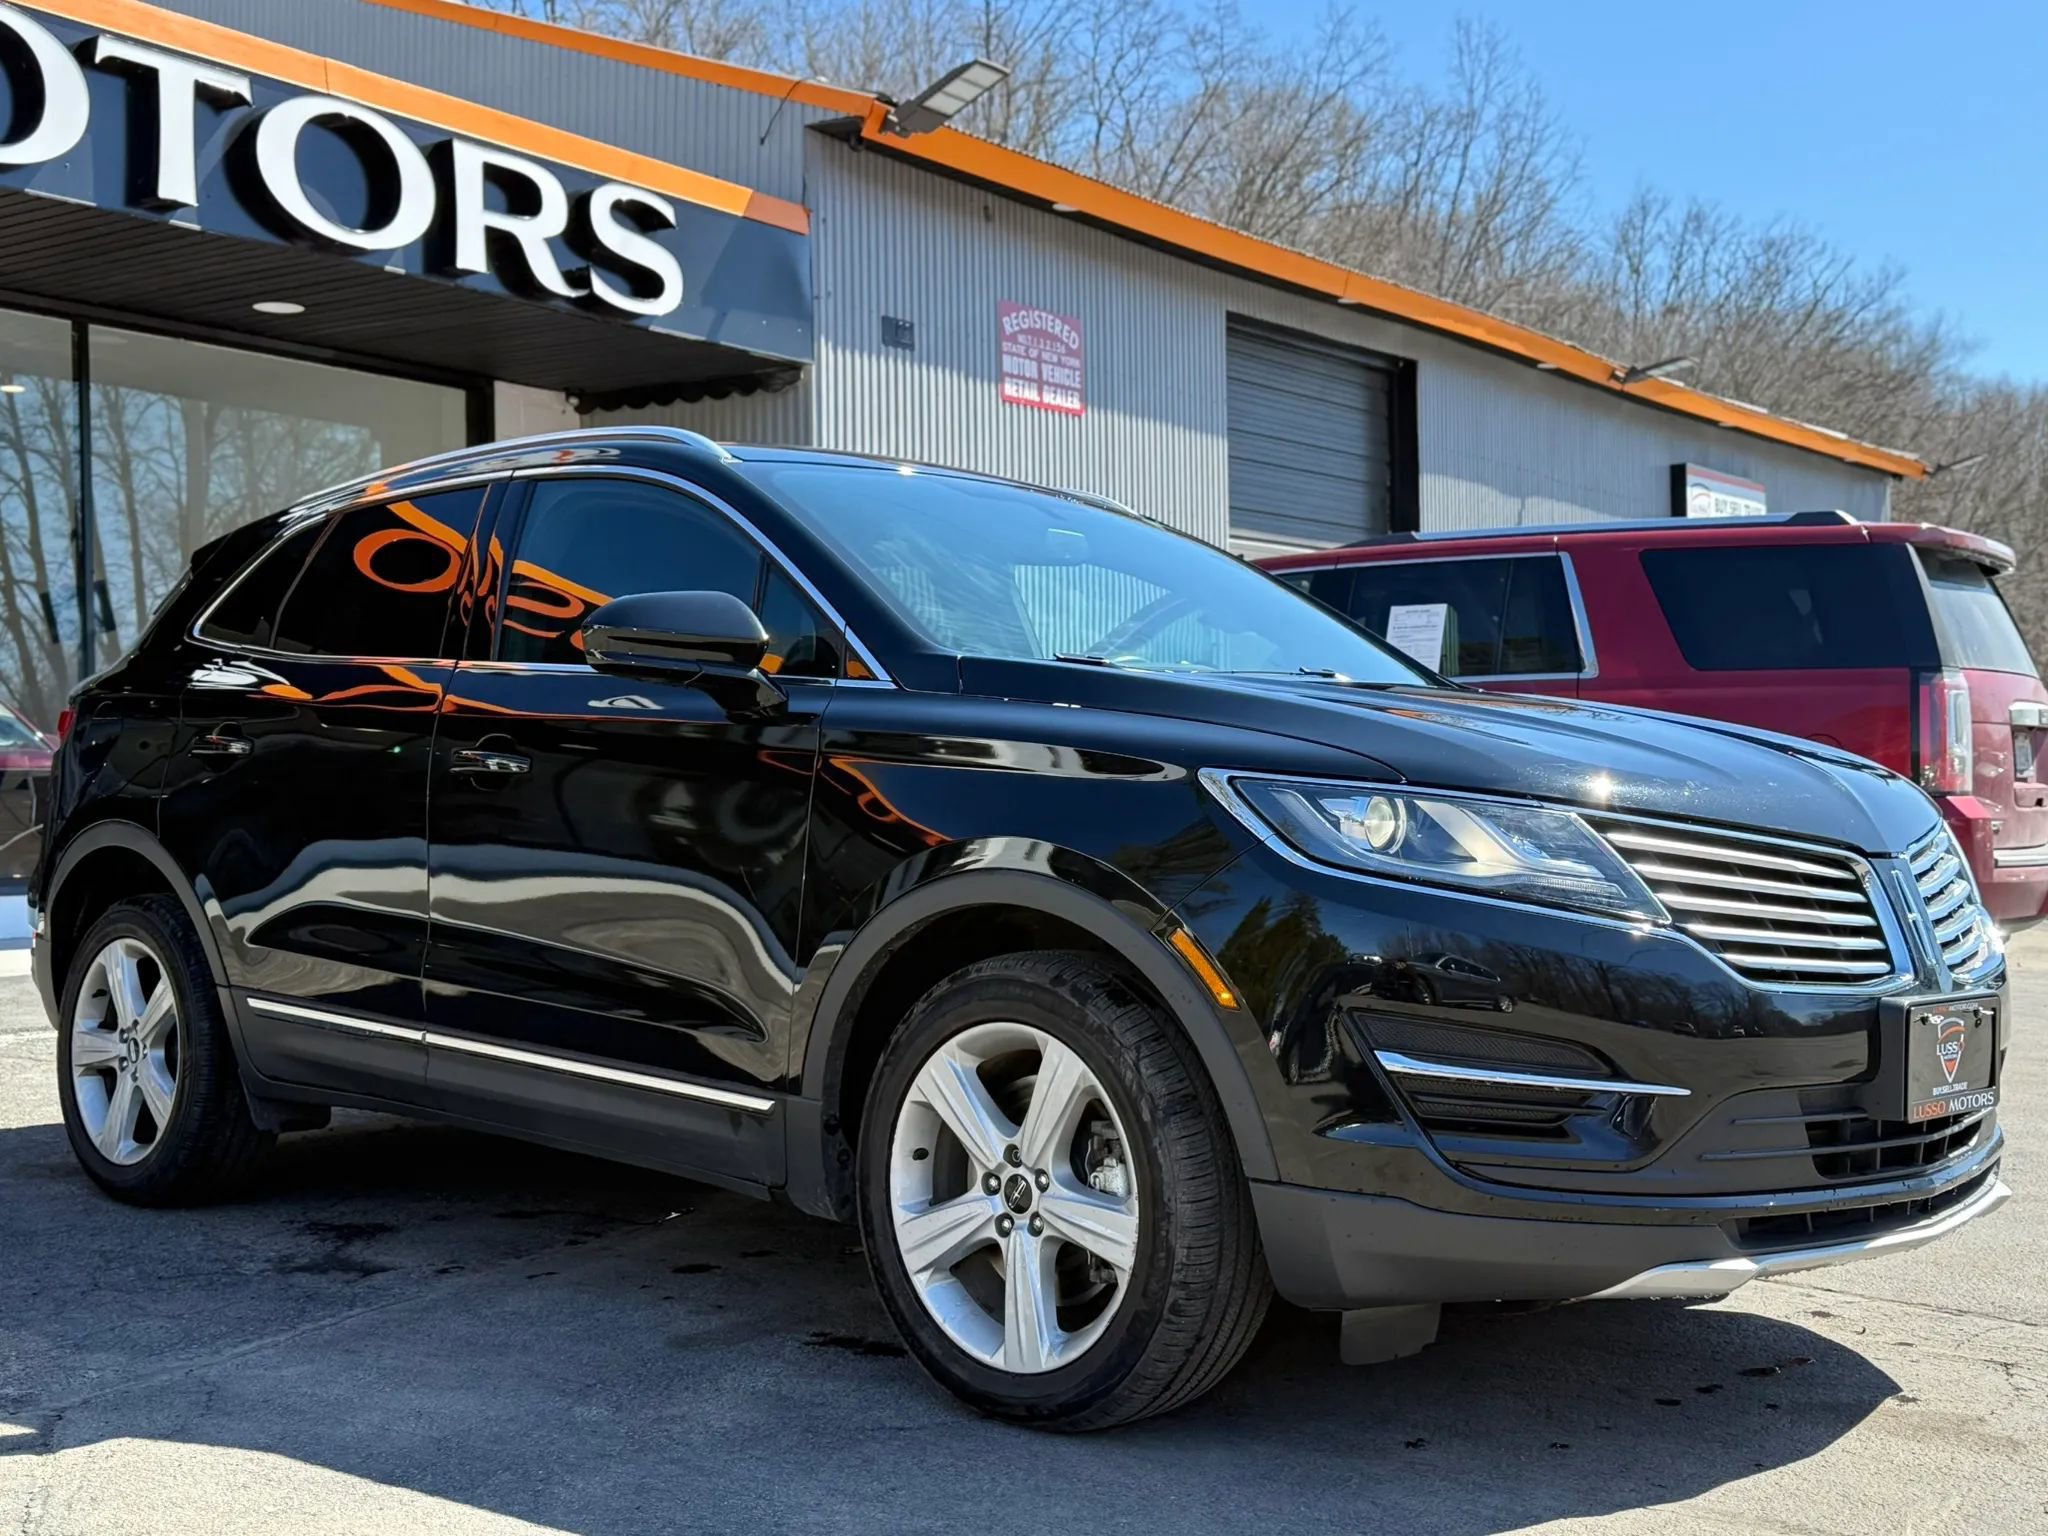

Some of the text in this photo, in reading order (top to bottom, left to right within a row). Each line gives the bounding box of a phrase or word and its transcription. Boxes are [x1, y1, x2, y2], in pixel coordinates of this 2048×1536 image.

[1002, 310, 1080, 350] REGISTERED
[1002, 341, 1027, 356] STATE
[1028, 347, 1039, 359] OF
[1041, 350, 1059, 363] NEW
[1002, 353, 1081, 388] MOTOR VEHICLE
[1004, 376, 1081, 410] RETAIL DEALER
[1913, 1091, 1994, 1119] LUSSO MOTORS
